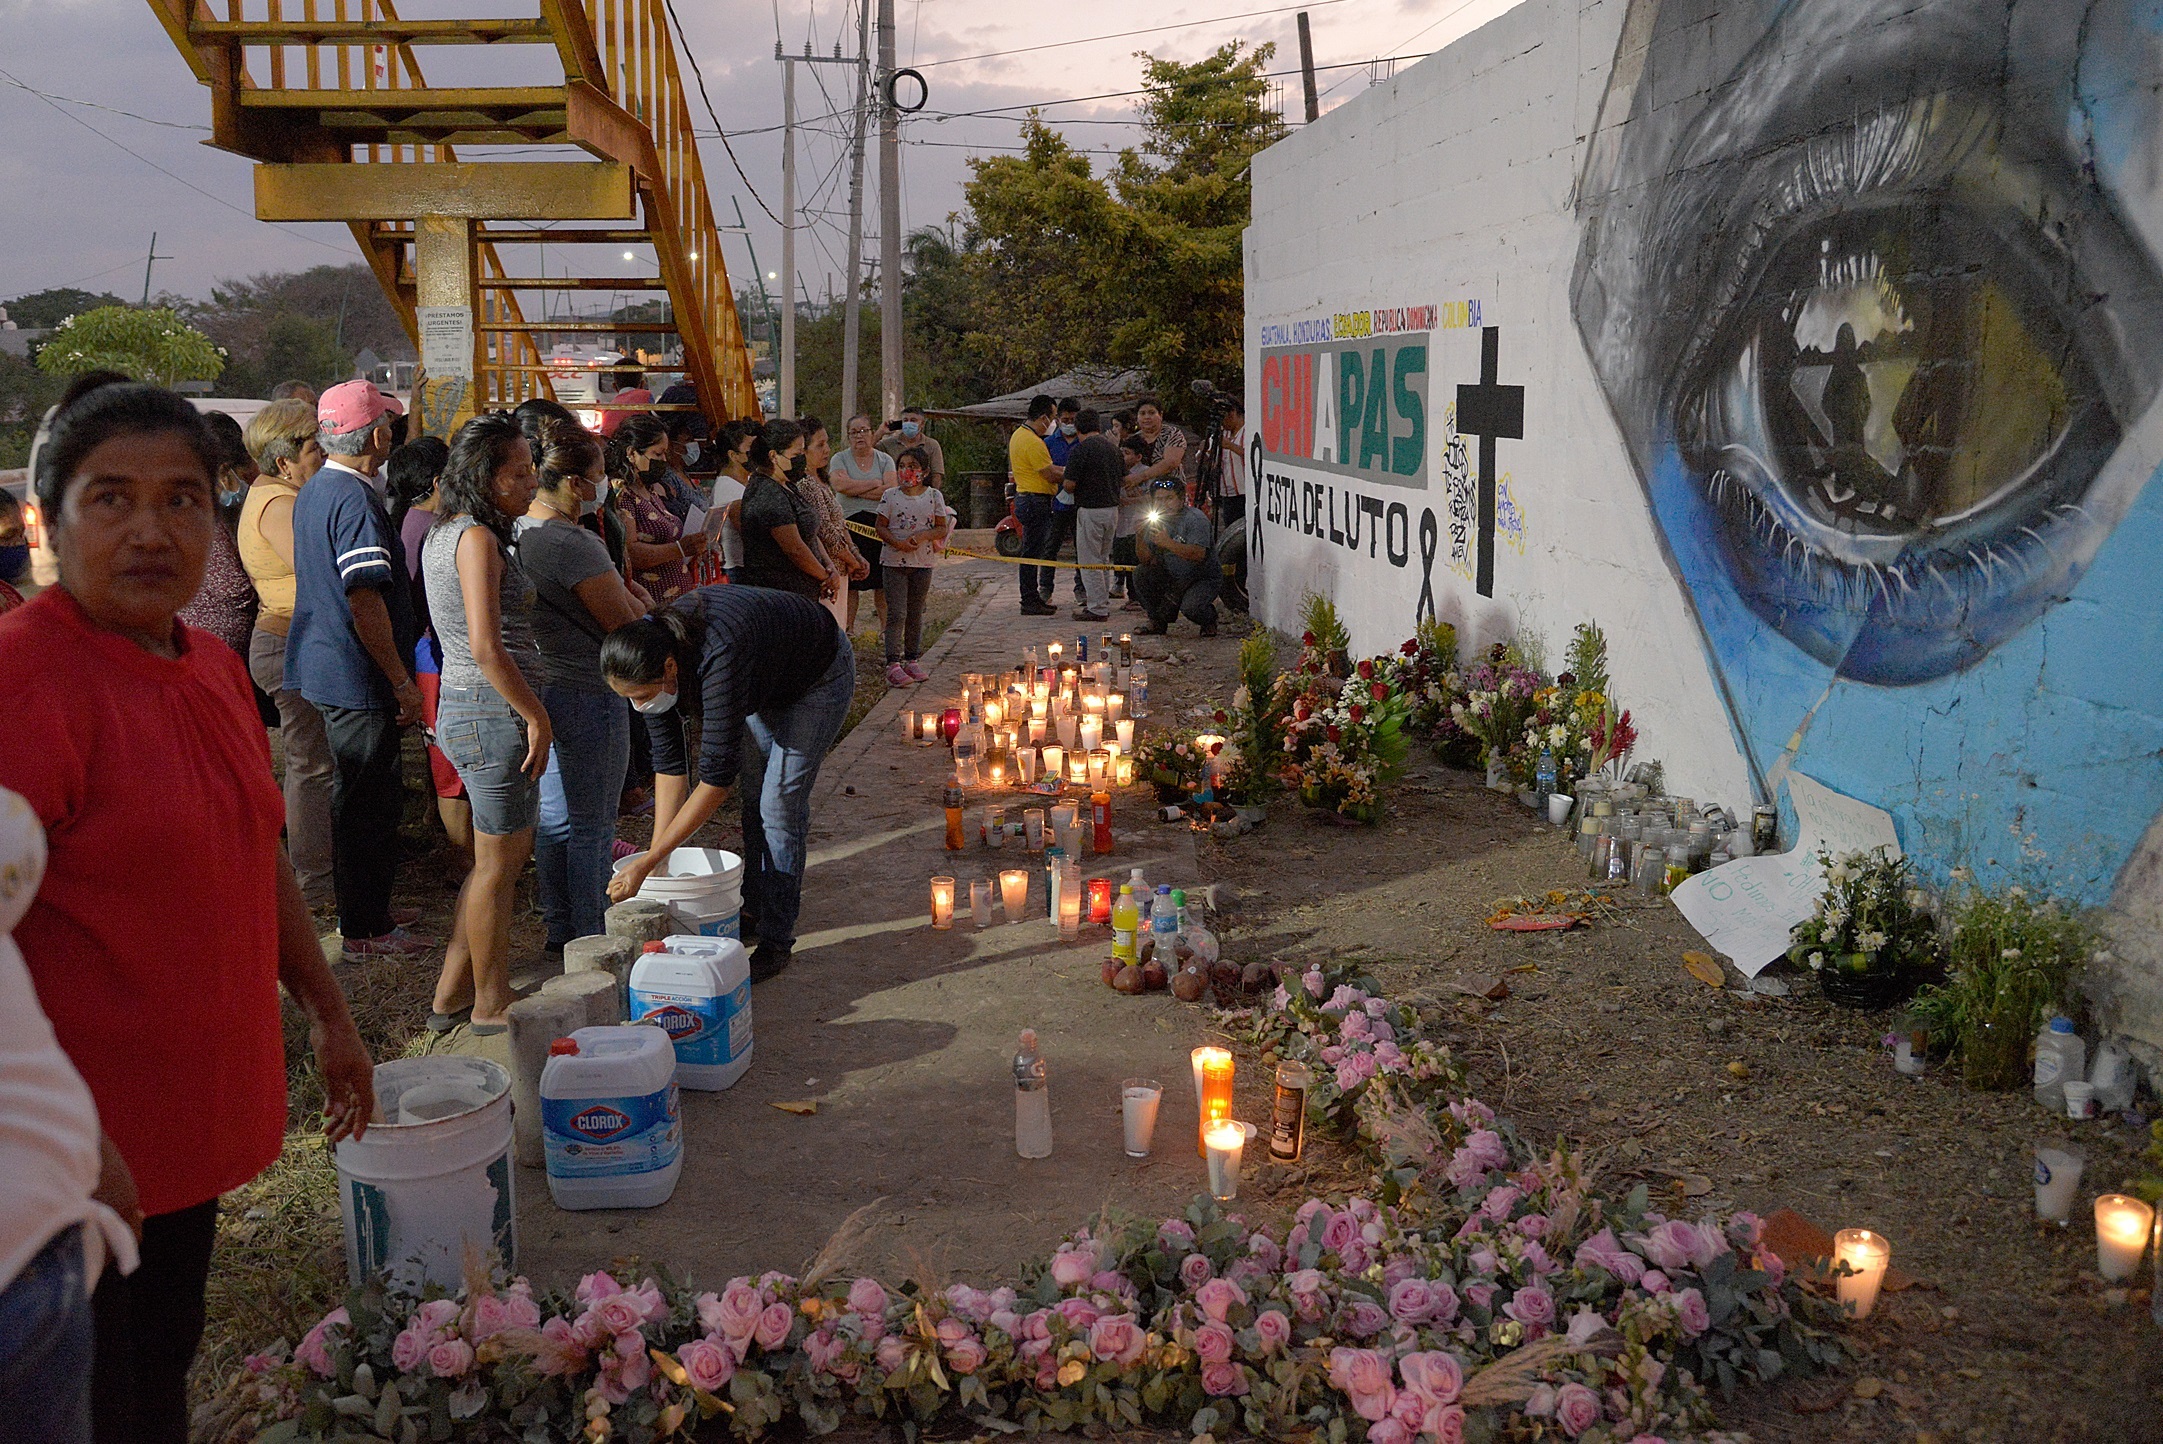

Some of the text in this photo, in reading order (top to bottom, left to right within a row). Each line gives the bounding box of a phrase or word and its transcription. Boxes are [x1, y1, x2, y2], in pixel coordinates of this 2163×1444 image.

[1442, 298, 1482, 329] COLOMBIA
[1261, 346, 1426, 476] CHIAPAS
[1266, 473, 1408, 568] ESTA DE LUTO
[1694, 869, 1733, 902] NO
[577, 1114, 623, 1130] CLOROX
